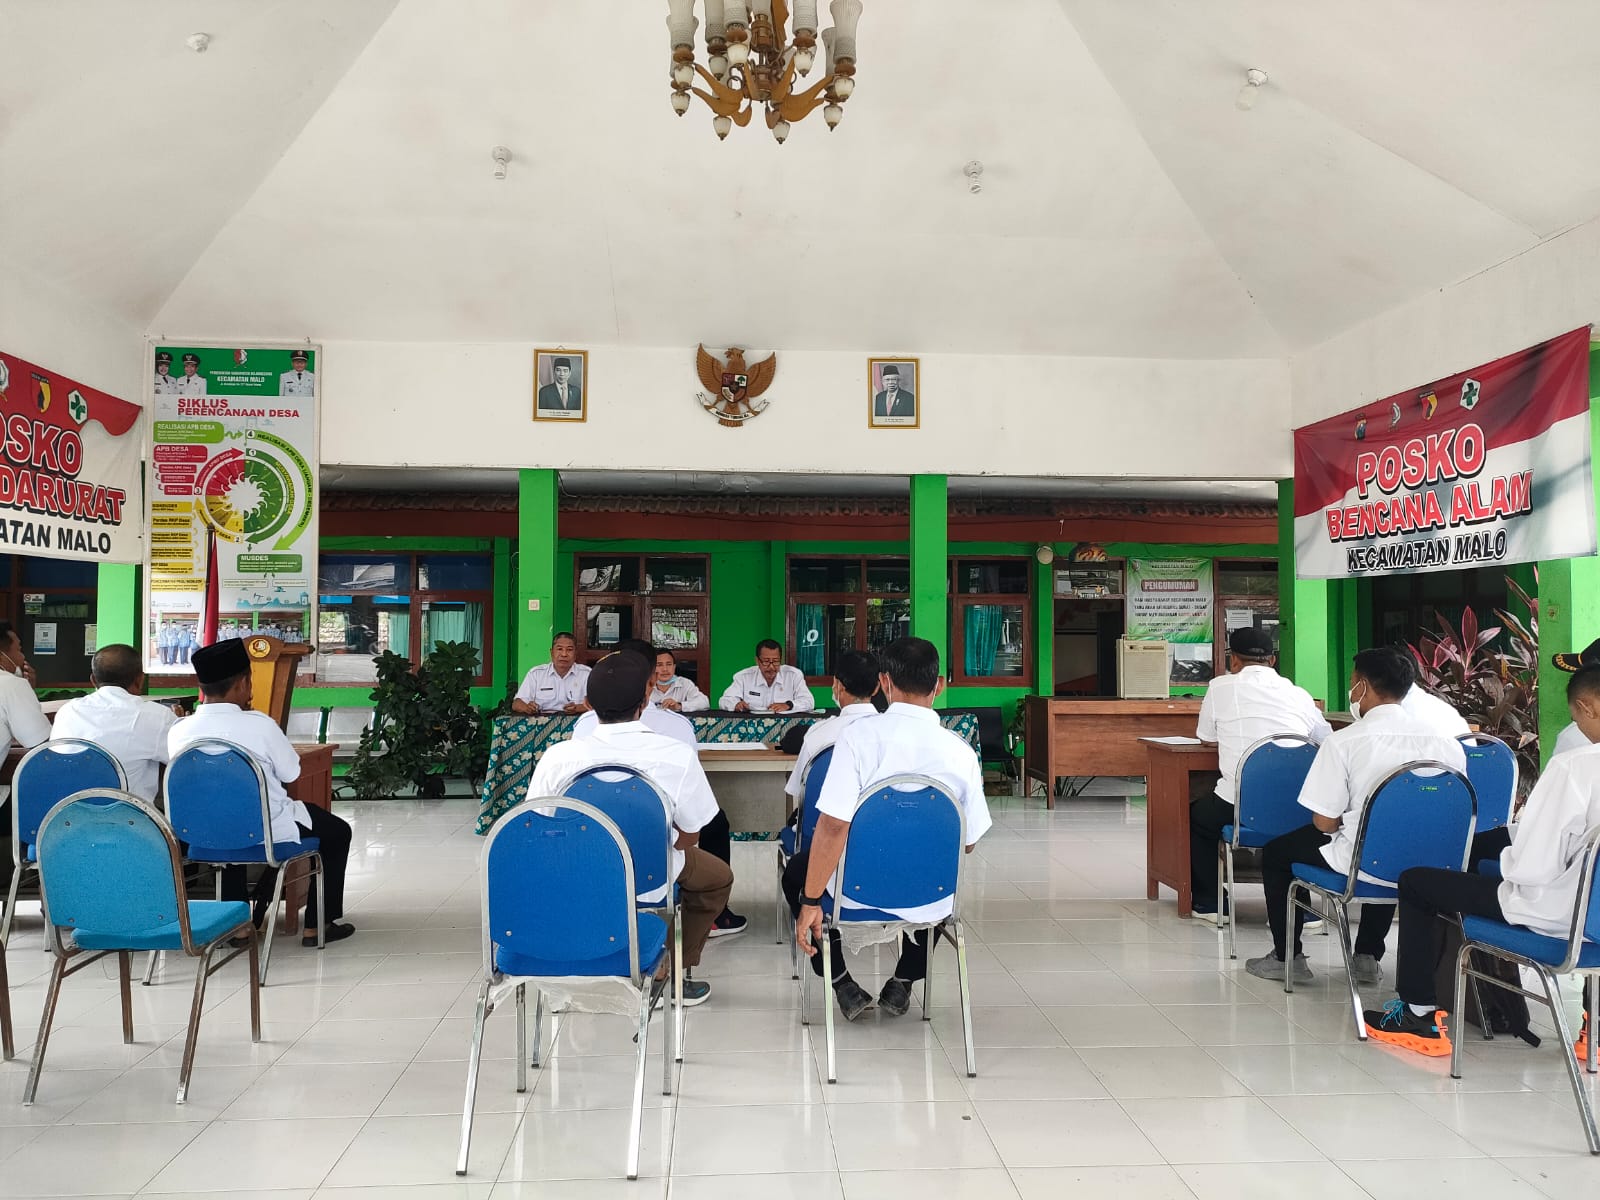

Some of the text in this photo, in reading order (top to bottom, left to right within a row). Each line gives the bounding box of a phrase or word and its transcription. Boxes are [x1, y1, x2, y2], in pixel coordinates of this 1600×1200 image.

[178, 398, 228, 408] SIKLUS
[178, 408, 265, 417] PERENCANAAN
[0, 412, 84, 477] SKO
[1356, 423, 1486, 500] POSKO
[0, 464, 126, 525] DARURAT
[1326, 470, 1533, 542] BENCANA ALAM
[58, 528, 111, 554] MALO
[1347, 529, 1507, 572] KECAMATAN MALO
